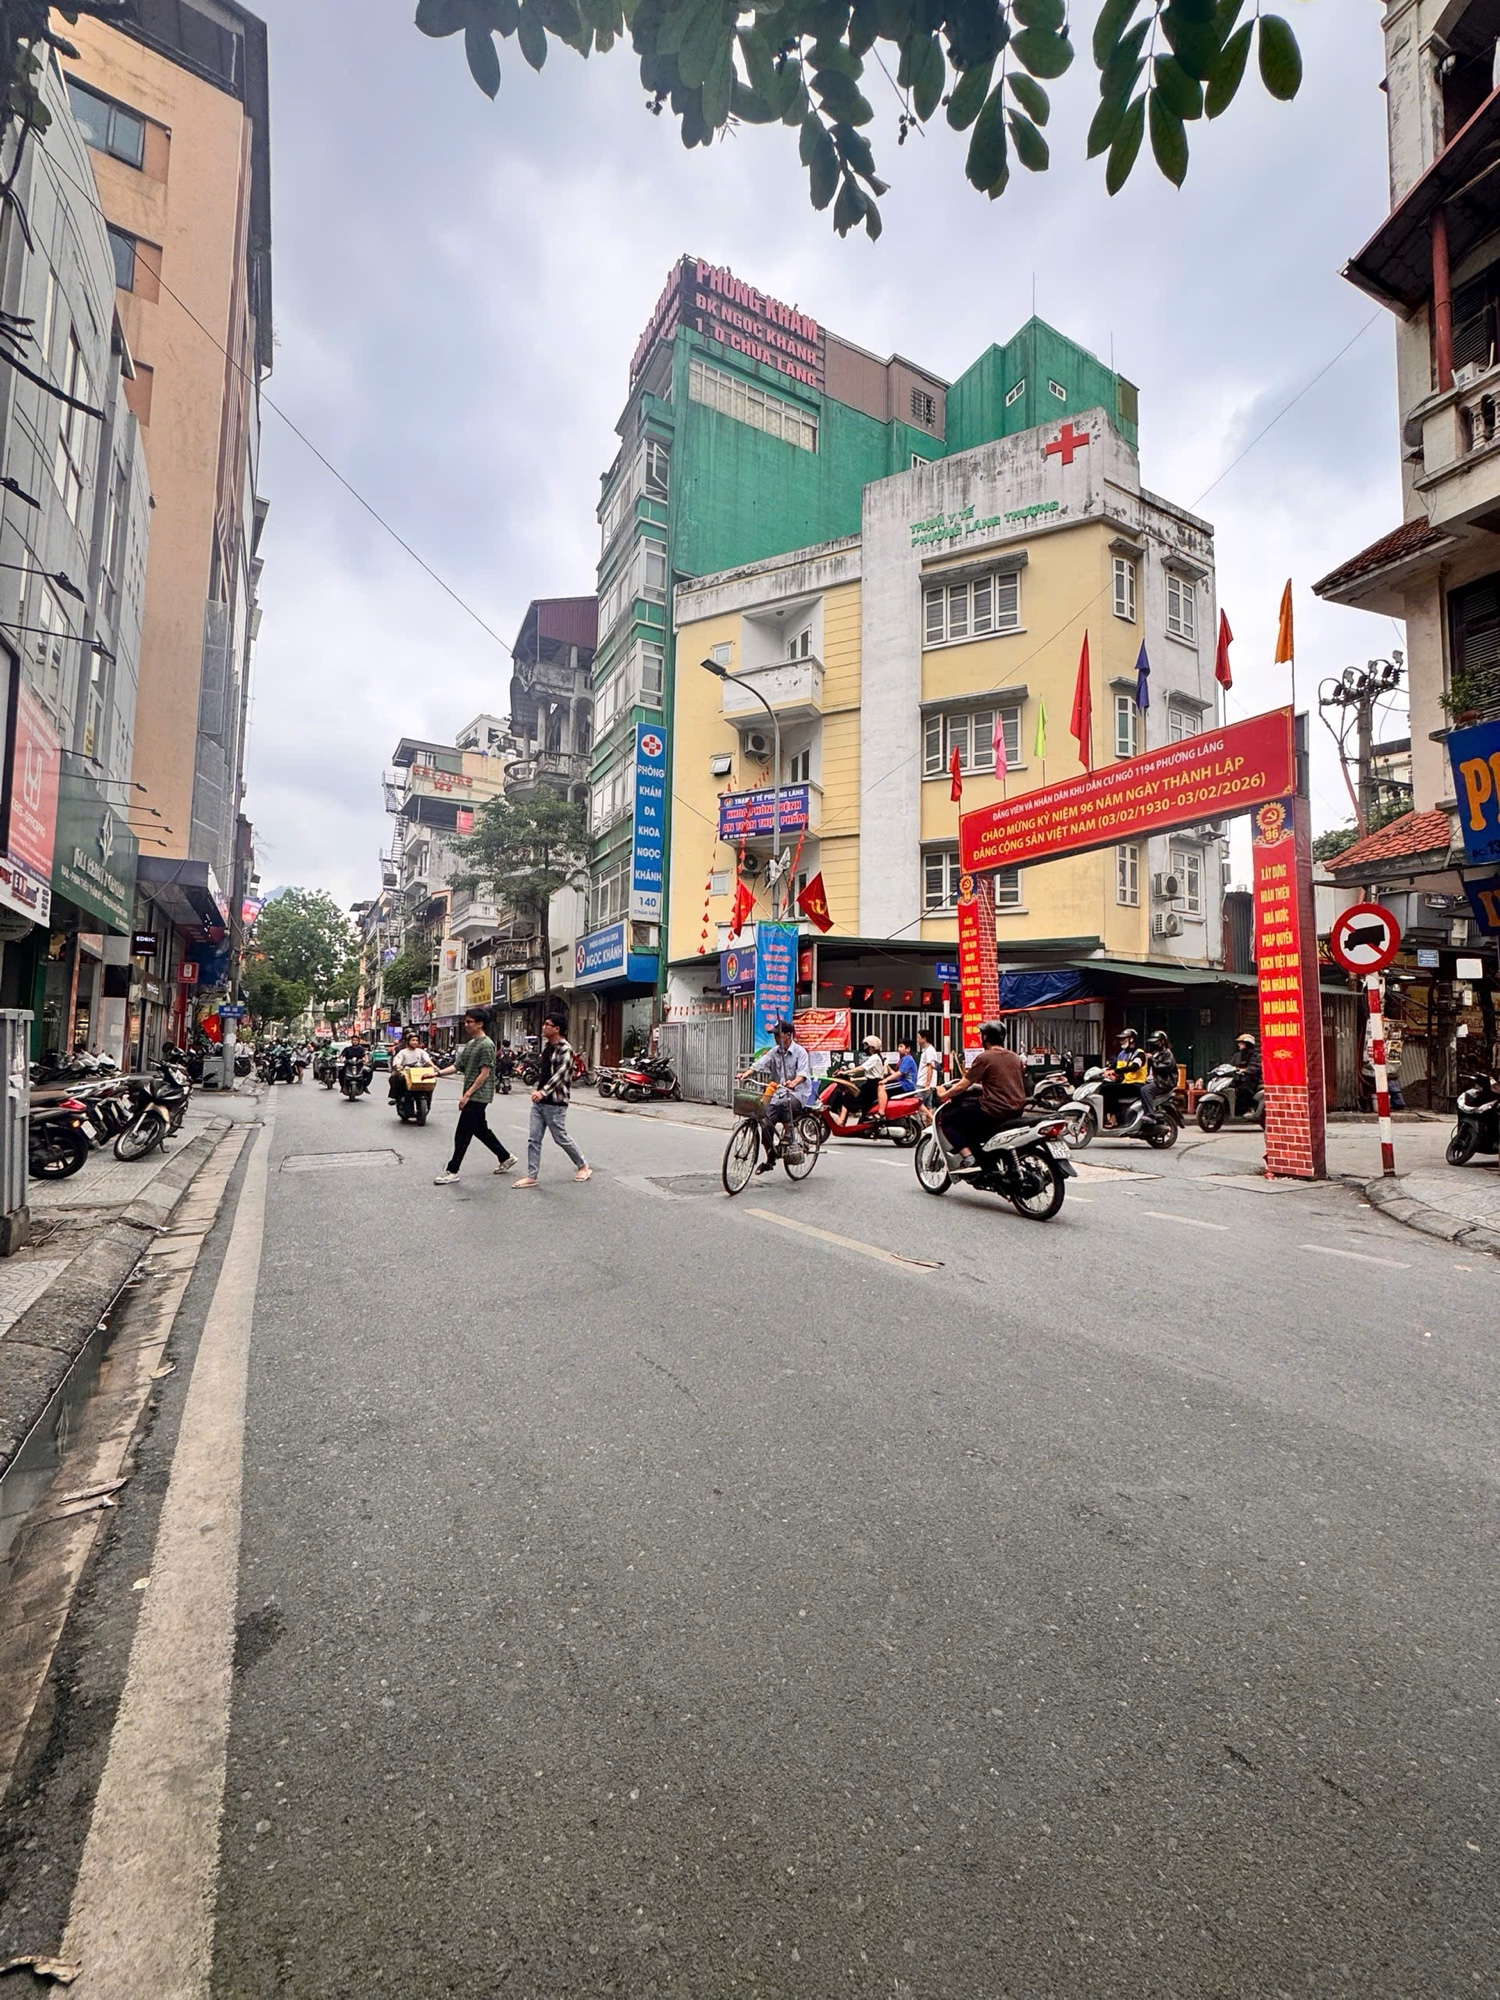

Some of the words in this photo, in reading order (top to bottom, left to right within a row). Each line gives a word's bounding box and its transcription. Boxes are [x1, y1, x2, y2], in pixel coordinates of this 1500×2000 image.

[696, 257, 760, 314] PHÒNG
[765, 294, 818, 343] KHÁM
[948, 513, 956, 524] Y
[966, 515, 1001, 533] LÁNG
[637, 764, 665, 779] PHÒNG
[1010, 803, 1025, 816] VIÊN
[1025, 800, 1034, 812] VÀ
[1034, 794, 1053, 809] NHÂN
[1053, 789, 1069, 803] DÂN
[1070, 784, 1086, 798] KHU
[1086, 779, 1102, 793] DÂN
[1103, 774, 1115, 788] CƯ
[1135, 762, 1155, 776] 1194
[1156, 747, 1196, 770] PHƯỜNG
[1197, 739, 1225, 757] LÁNG
[639, 785, 662, 798] KHÁM
[788, 788, 805, 797] LÁNG
[981, 825, 1006, 843] CHÀO
[1006, 816, 1037, 836] MỪNG
[1037, 811, 1050, 828] KỶ
[1051, 804, 1079, 824] NIỆM
[1080, 800, 1094, 815] 96
[1096, 791, 1124, 812] NĂM
[1125, 779, 1160, 802] NGÀY
[1162, 766, 1213, 792] THÀNH
[1215, 756, 1245, 778] LẬP
[643, 805, 656, 817] ĐA
[638, 825, 661, 838] KHOA
[973, 843, 998, 861] ĐẢNG
[998, 836, 1024, 855] CỘNG
[1025, 830, 1046, 848] SẢN
[1046, 824, 1069, 842] VIỆT
[1070, 818, 1097, 836] NAM
[636, 847, 661, 863] NGỌC
[635, 866, 662, 882] KHÁNH
[638, 896, 657, 908] 140
[586, 951, 602, 969] NGỌC
[602, 943, 622, 963] KHÁNH
